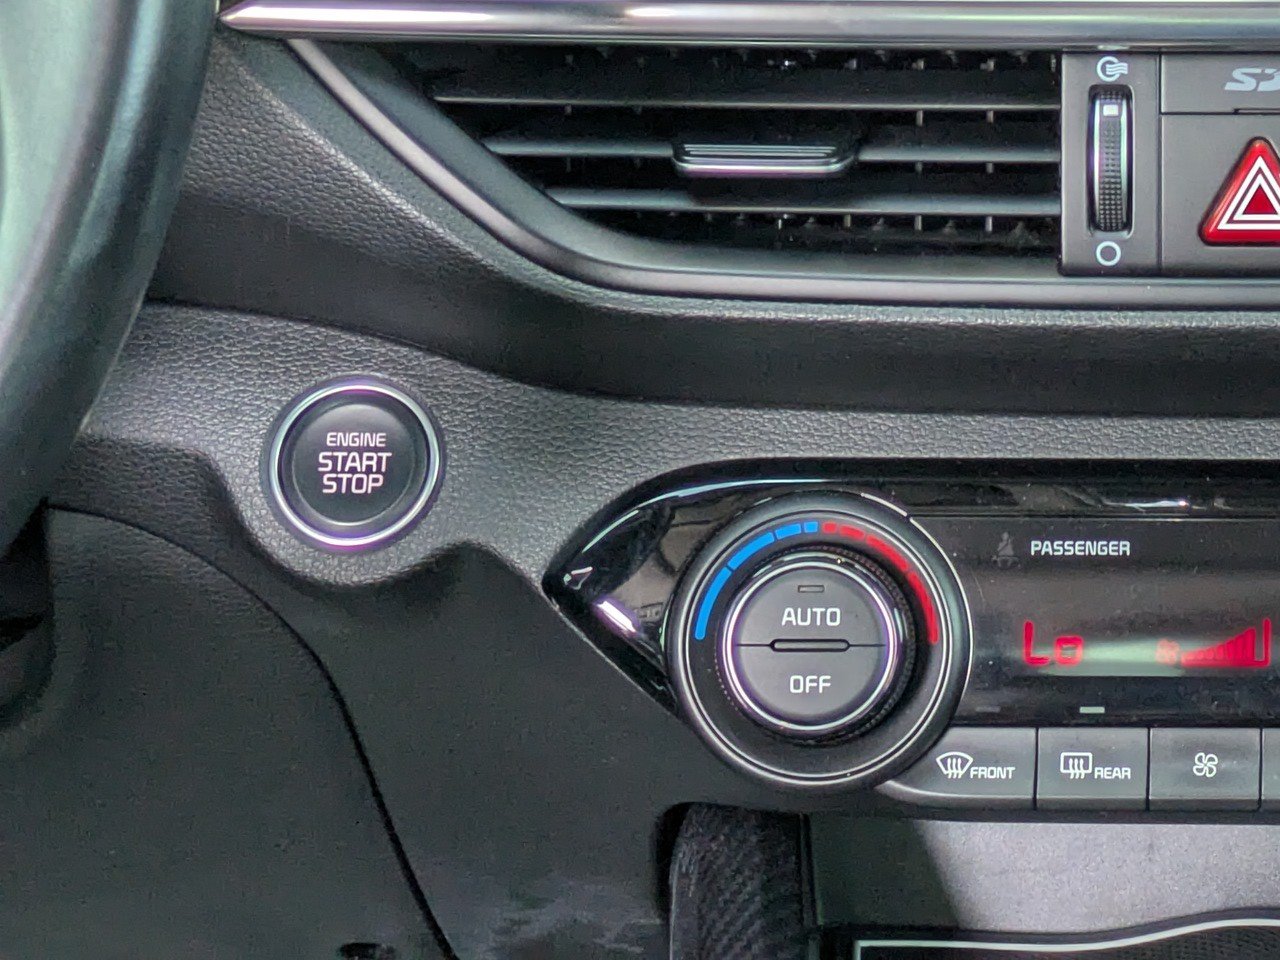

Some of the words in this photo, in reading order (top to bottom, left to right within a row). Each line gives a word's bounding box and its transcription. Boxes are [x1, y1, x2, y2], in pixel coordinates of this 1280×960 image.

[326, 432, 387, 447] ENGINE
[318, 451, 392, 472] START
[322, 473, 384, 494] STOP
[1030, 540, 1131, 556] PASSENGER
[781, 607, 841, 626] AUTO
[1023, 620, 1084, 666] Lo
[789, 675, 832, 694] OFF
[969, 766, 1016, 780] FRONT
[1094, 766, 1131, 780] REAR
